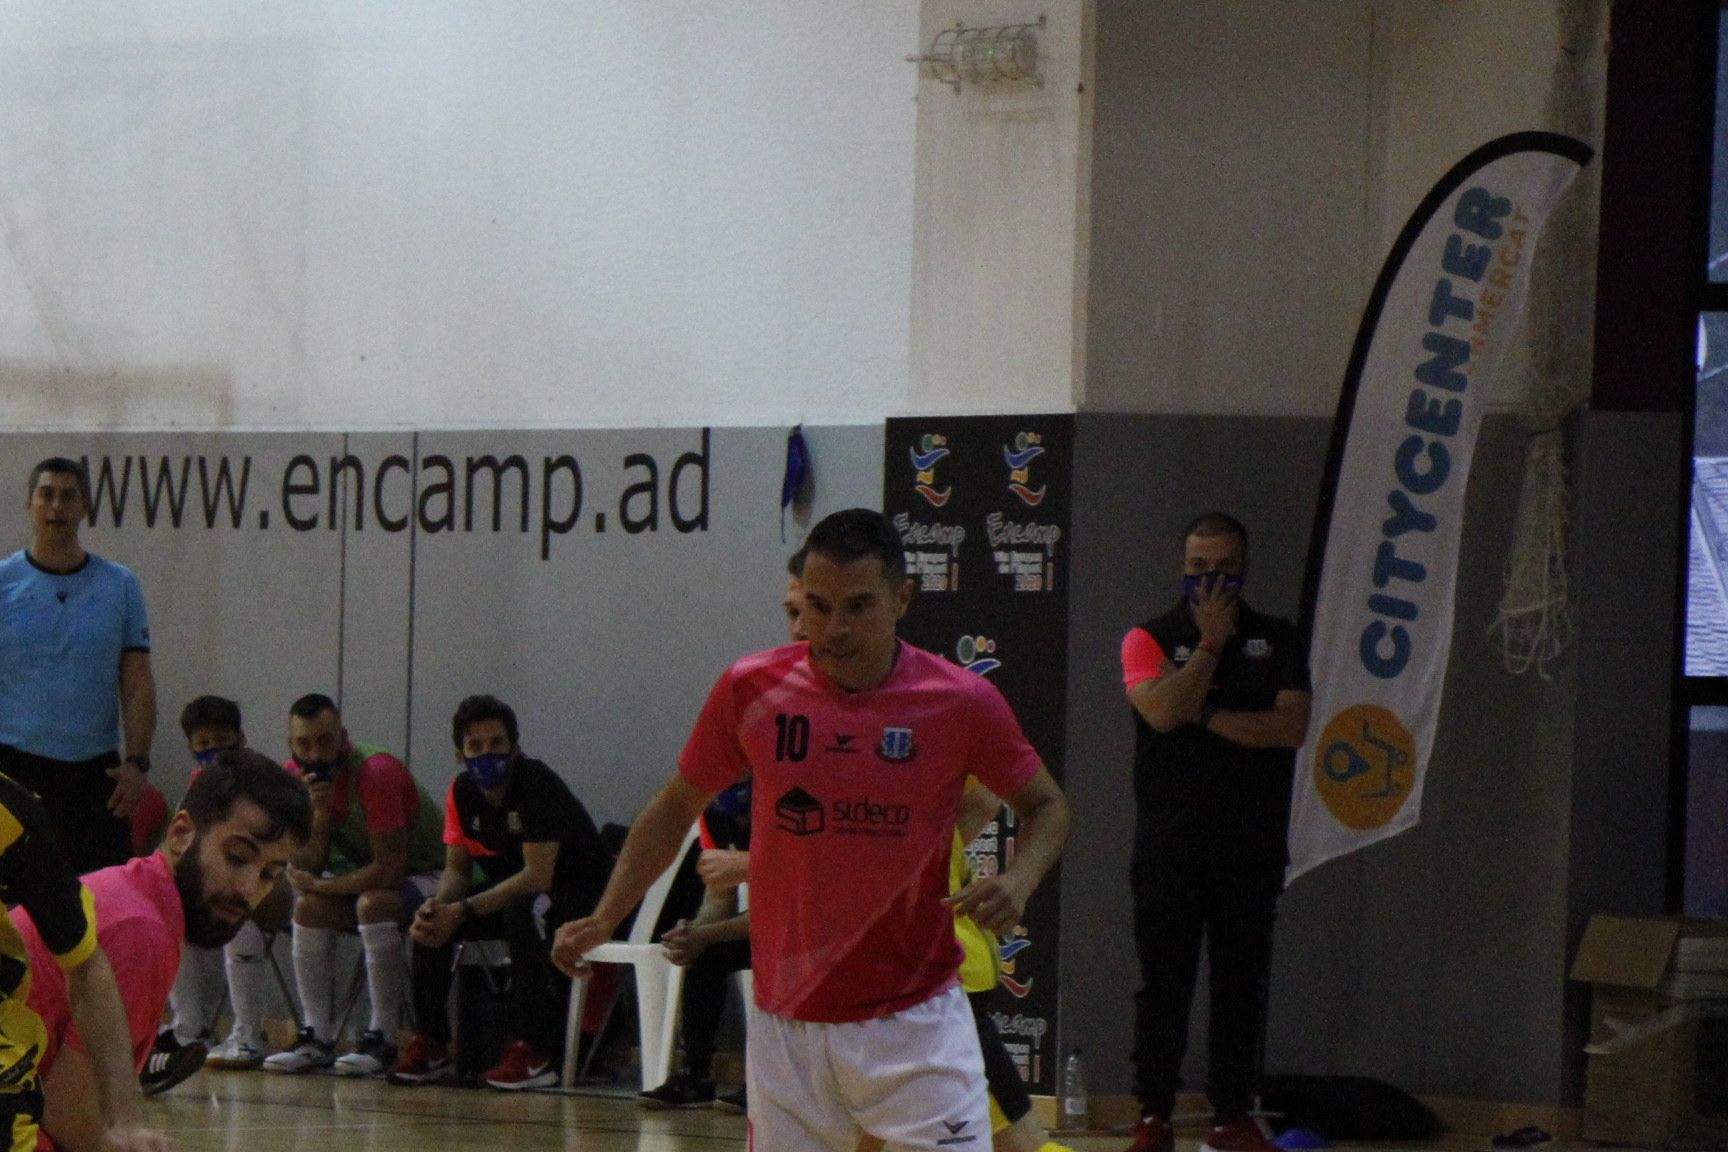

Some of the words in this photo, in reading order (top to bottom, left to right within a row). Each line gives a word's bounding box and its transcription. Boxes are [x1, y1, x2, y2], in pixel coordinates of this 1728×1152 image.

[80, 427, 711, 561] www.encamp.ad
[1359, 185, 1513, 679] CITYCENTER
[775, 712, 811, 762] 10
